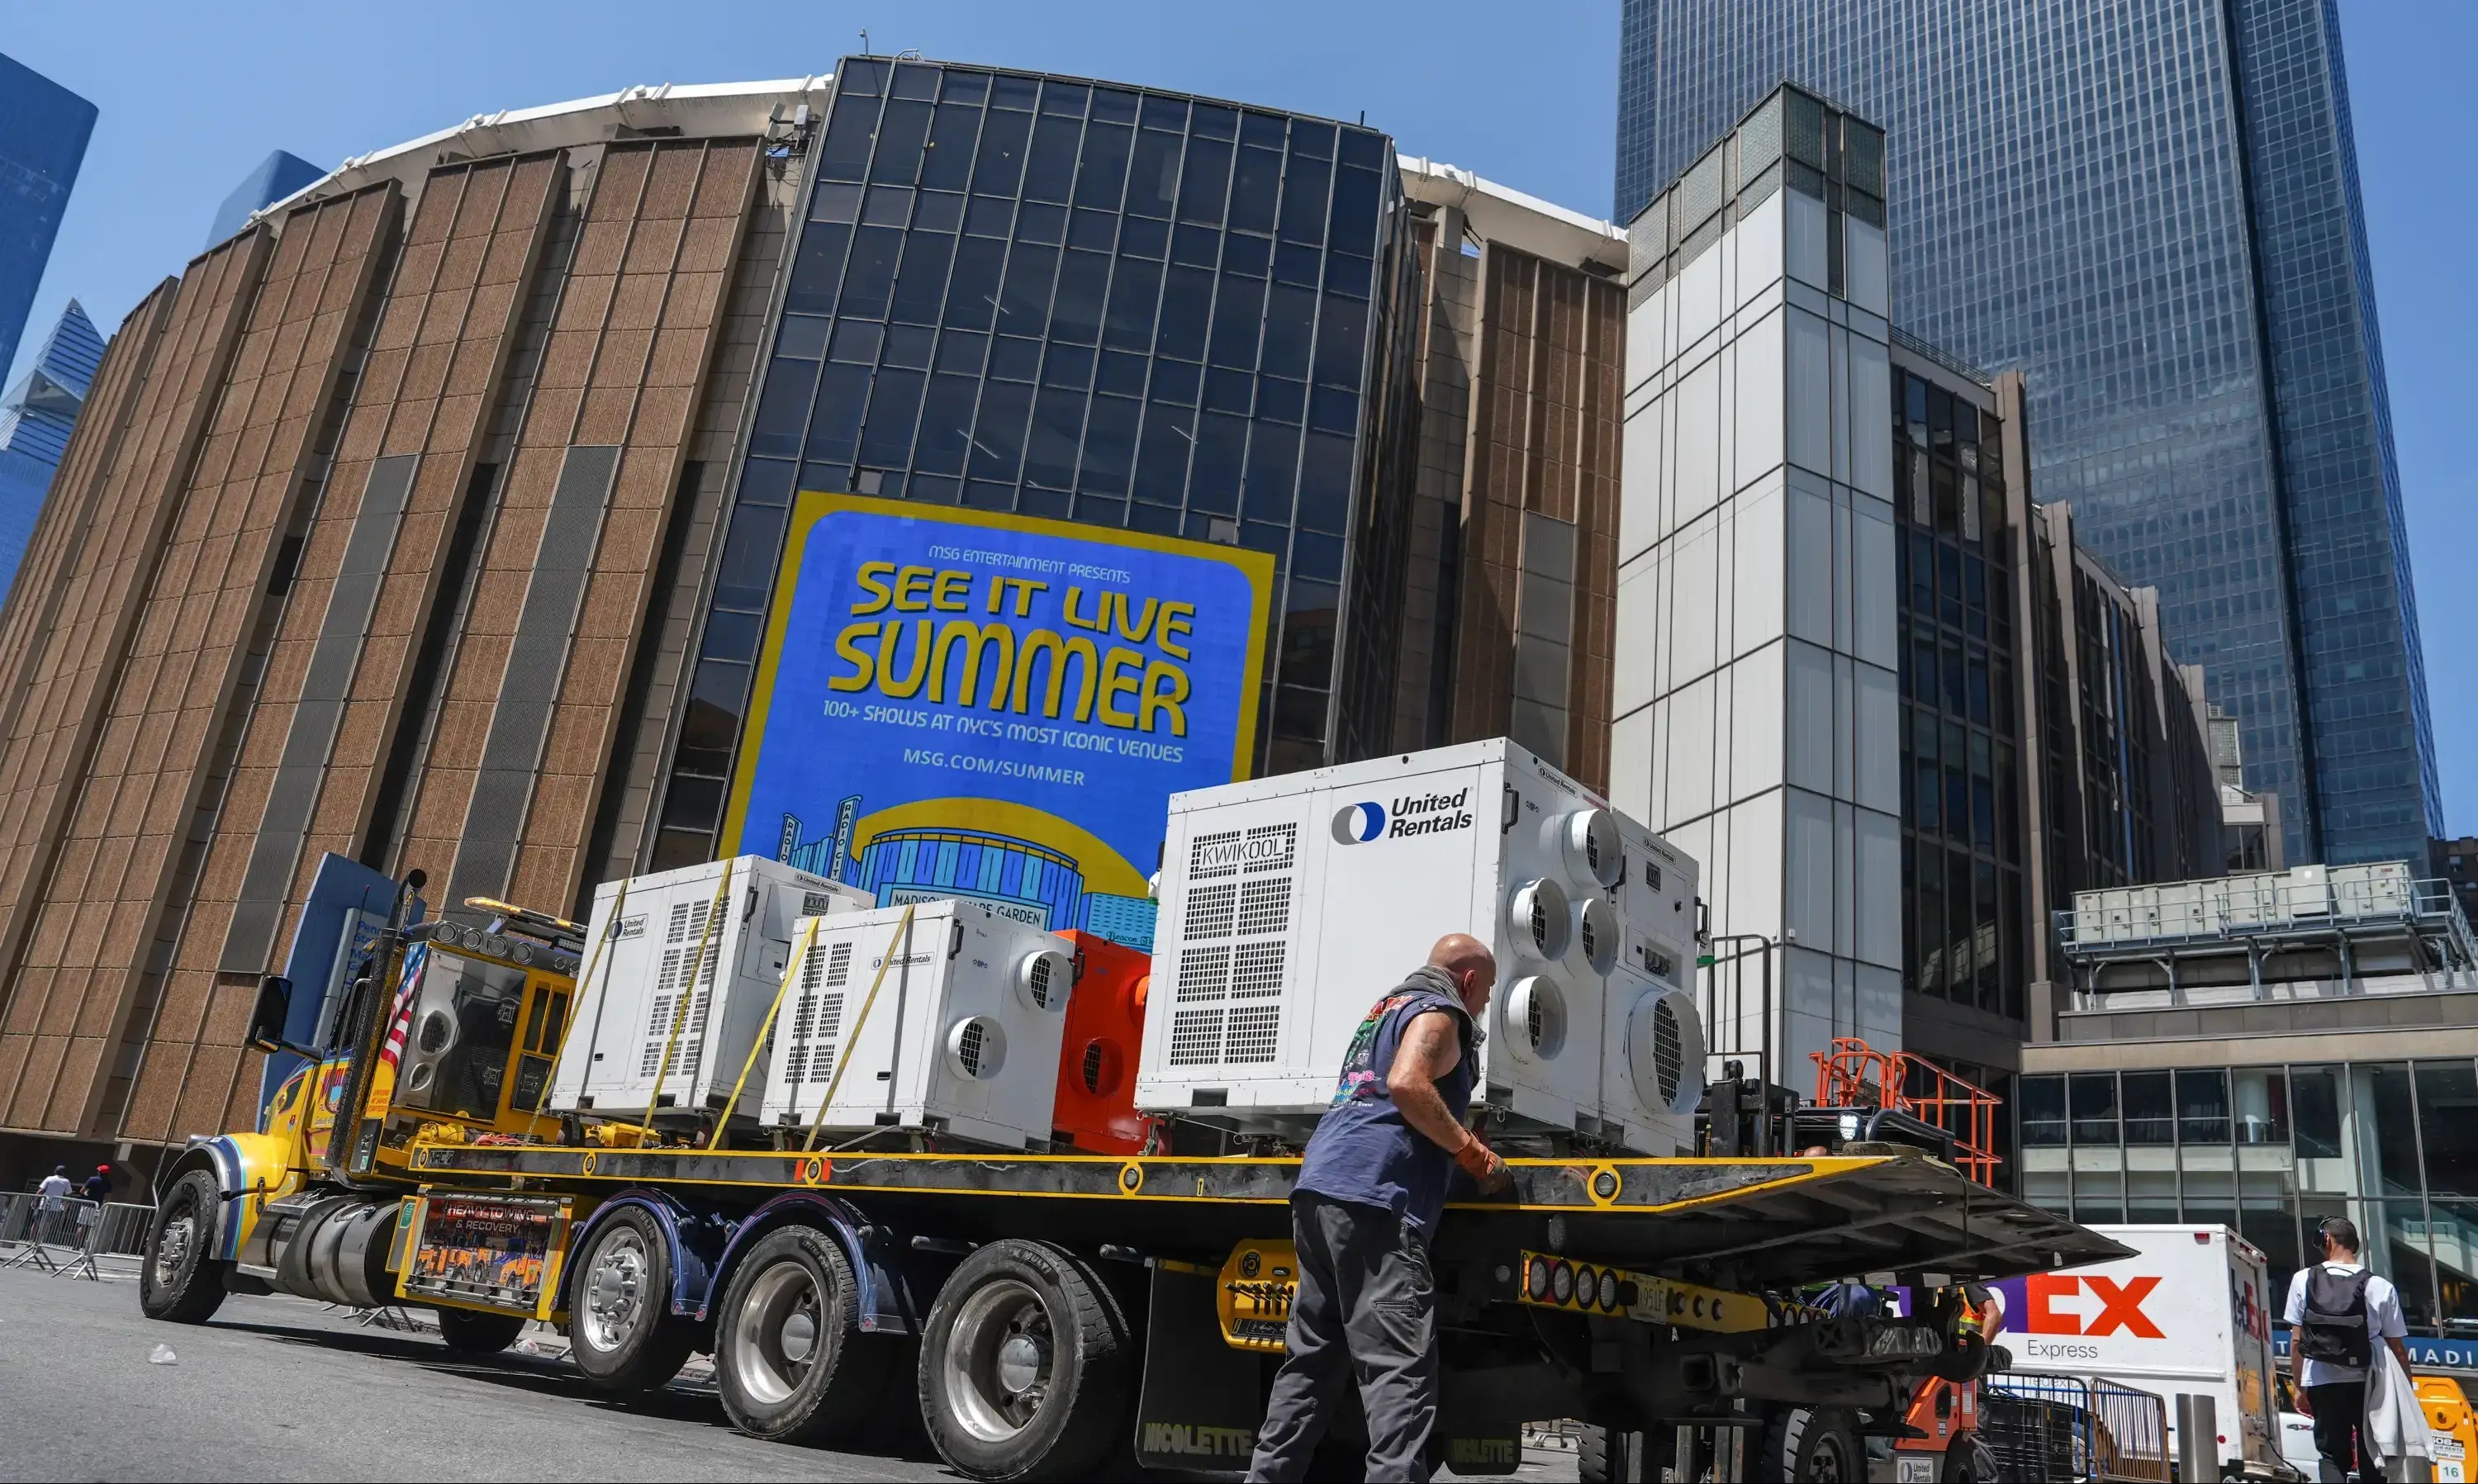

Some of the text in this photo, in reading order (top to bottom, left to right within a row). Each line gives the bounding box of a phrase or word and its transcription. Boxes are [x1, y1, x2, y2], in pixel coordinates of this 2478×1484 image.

[928, 545, 1131, 584] MSG ENTERTAINMENT PRESENTS
[850, 560, 1197, 661] SEE IT LIVE
[827, 619, 1192, 737] SUMMER
[823, 699, 1184, 763] 100+ SHOWS AT NYC'S MOST ICONIC VENUES
[903, 748, 1085, 785] MSG.COM/SUMMER
[1392, 787, 1468, 817] United
[838, 804, 852, 846] RADIO
[1389, 810, 1473, 839] Rentals
[781, 822, 794, 861] RADIO
[1203, 838, 1284, 865] KWIKOOL
[624, 917, 646, 928] United
[895, 894, 1042, 924] MADISO GARDEN
[622, 927, 644, 937] Rentals
[888, 955, 931, 966] nited Rentals
[447, 1203, 535, 1222] HEAVY TOWING
[455, 1220, 520, 1234] & RECOVERY
[2028, 1339, 2099, 1359] Express
[1143, 1422, 1253, 1457] NICOLETTE
[1913, 1462, 1930, 1472] United
[2442, 1466, 2459, 1477] 16
